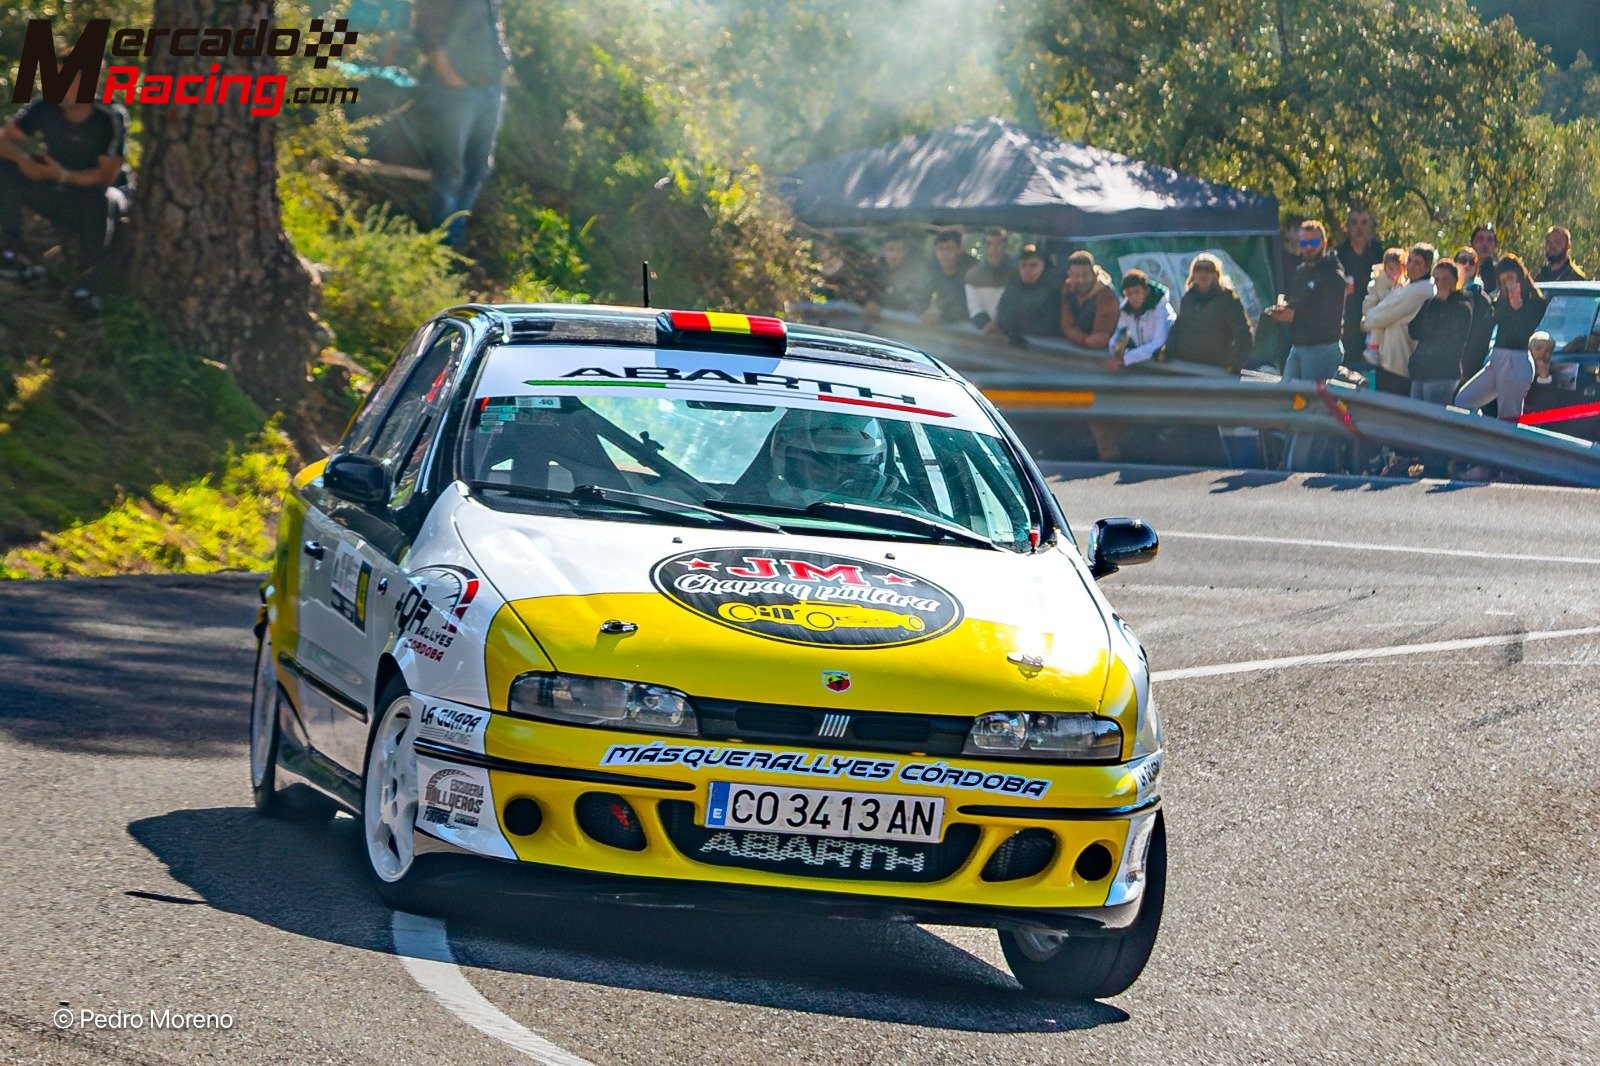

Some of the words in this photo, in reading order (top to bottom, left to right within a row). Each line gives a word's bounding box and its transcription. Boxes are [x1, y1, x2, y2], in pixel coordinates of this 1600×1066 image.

[559, 367, 916, 405] ABARTH
[726, 557, 871, 588] JM
[674, 574, 785, 597] Chapa
[814, 584, 941, 612] pintura
[604, 743, 895, 779] MÁSQUERALLYES
[900, 761, 1050, 797] CÓRDOBA
[712, 808, 722, 819] E
[731, 789, 780, 826] CO
[785, 793, 881, 832] 3413
[886, 799, 935, 836] AN
[699, 831, 925, 873] ABARTH
